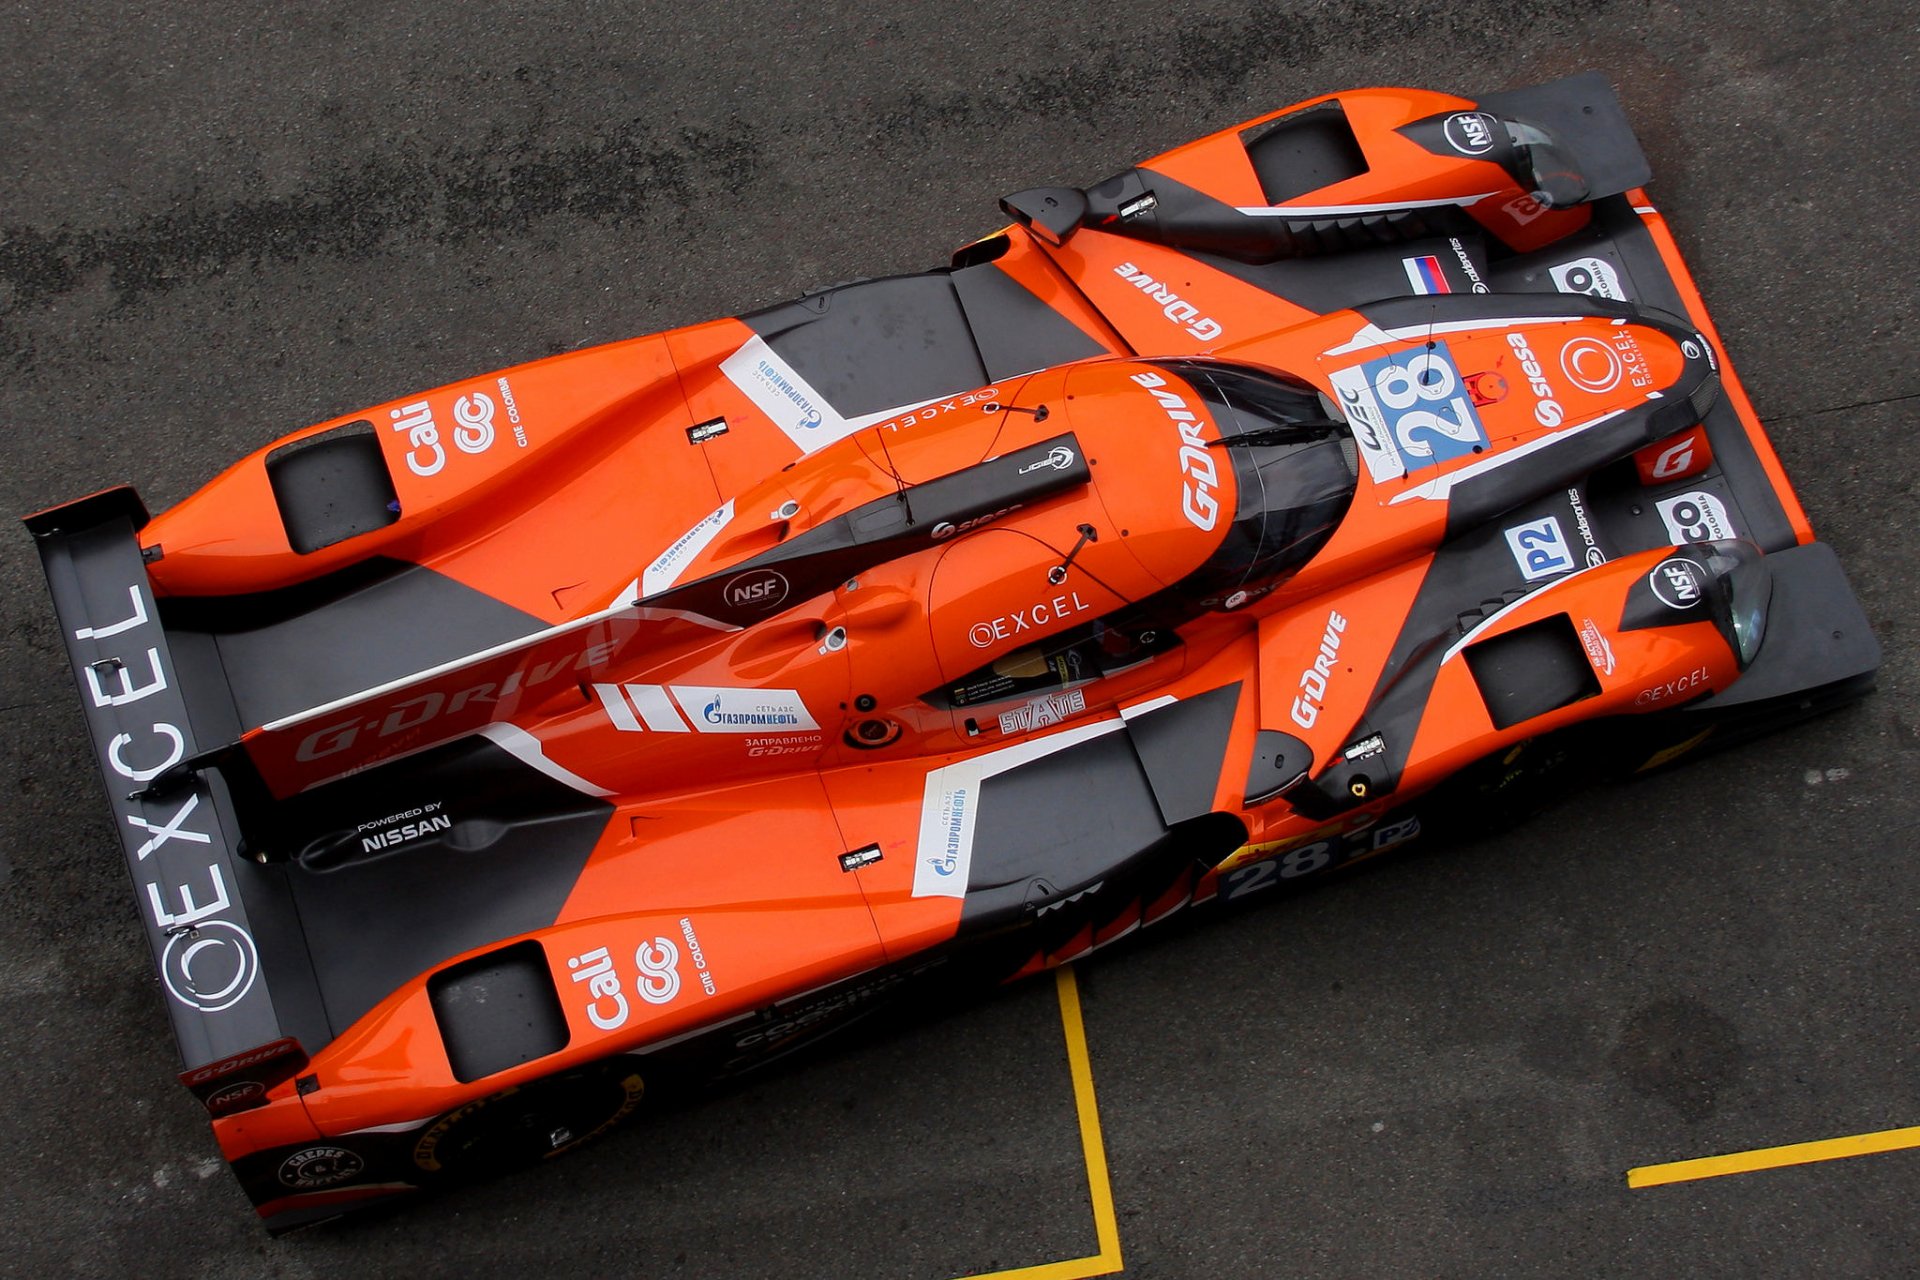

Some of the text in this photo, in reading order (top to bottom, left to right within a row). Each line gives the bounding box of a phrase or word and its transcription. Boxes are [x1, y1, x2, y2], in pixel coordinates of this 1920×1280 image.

[1457, 116, 1487, 146] NSF
[1611, 330, 1647, 388] EXCEL
[882, 395, 977, 434] EXCEL
[1339, 386, 1382, 451] WEC
[1375, 353, 1481, 457] 28
[391, 400, 445, 476] Cali
[1698, 494, 1724, 540] COLOMBIA
[1517, 523, 1566, 573] P2
[734, 578, 776, 602] NSF
[1663, 566, 1696, 600] NSF
[995, 591, 1090, 640] EXCEL
[1651, 666, 1710, 701] EXCEL
[722, 713, 798, 725] ГАЗПРОМНЕФТЬ
[997, 688, 1086, 735] STATE
[76, 585, 231, 928] EXCEL
[745, 734, 822, 747] ЗАПРАВЛЕНО
[357, 800, 443, 833] POWERED BY
[360, 814, 452, 853] NISSAN
[1228, 841, 1330, 900] 28
[566, 946, 629, 1031] Cali
[214, 1083, 254, 1106] NSF
